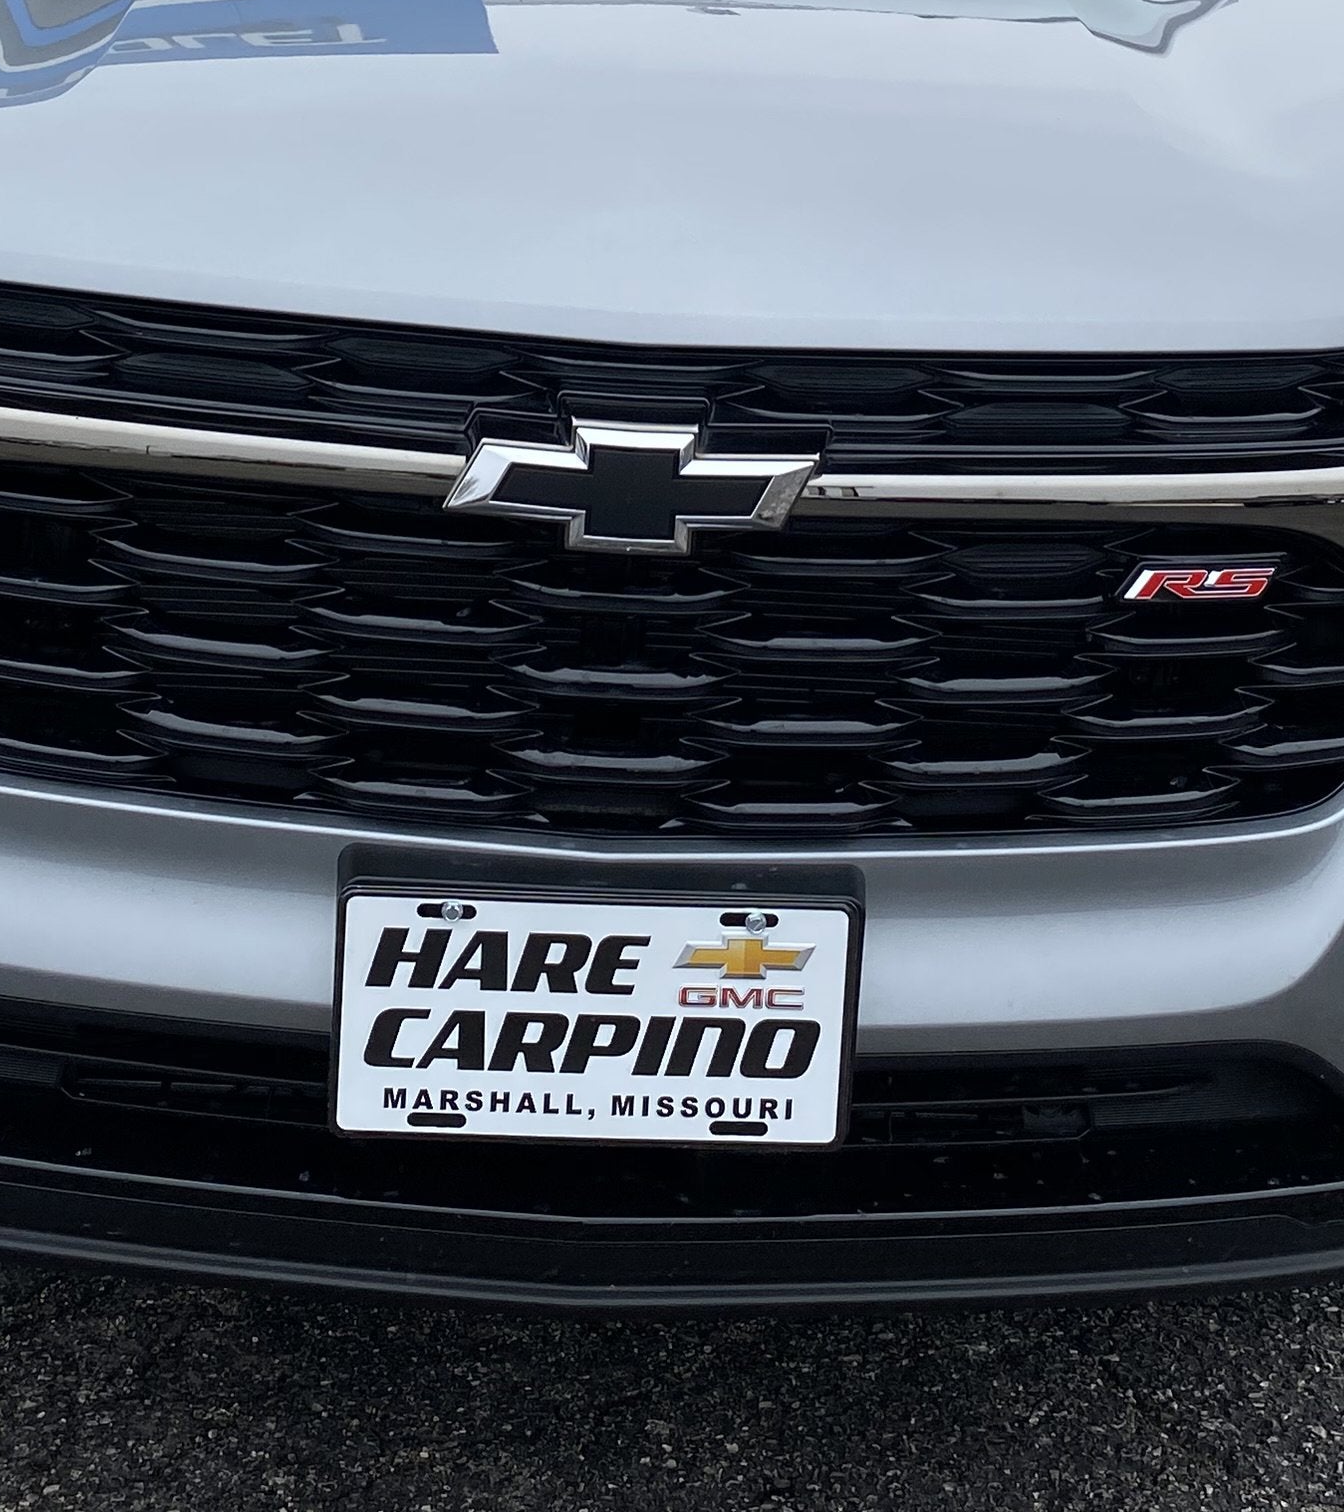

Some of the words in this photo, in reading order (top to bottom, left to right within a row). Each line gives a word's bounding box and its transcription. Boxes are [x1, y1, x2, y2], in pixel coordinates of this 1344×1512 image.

[1123, 567, 1278, 600] RS
[364, 926, 652, 995] HARE
[677, 983, 807, 1011] GMC
[362, 1007, 822, 1079] CARPINO
[382, 1087, 596, 1120] MARSHALL,
[610, 1095, 794, 1121] MISSOURI
